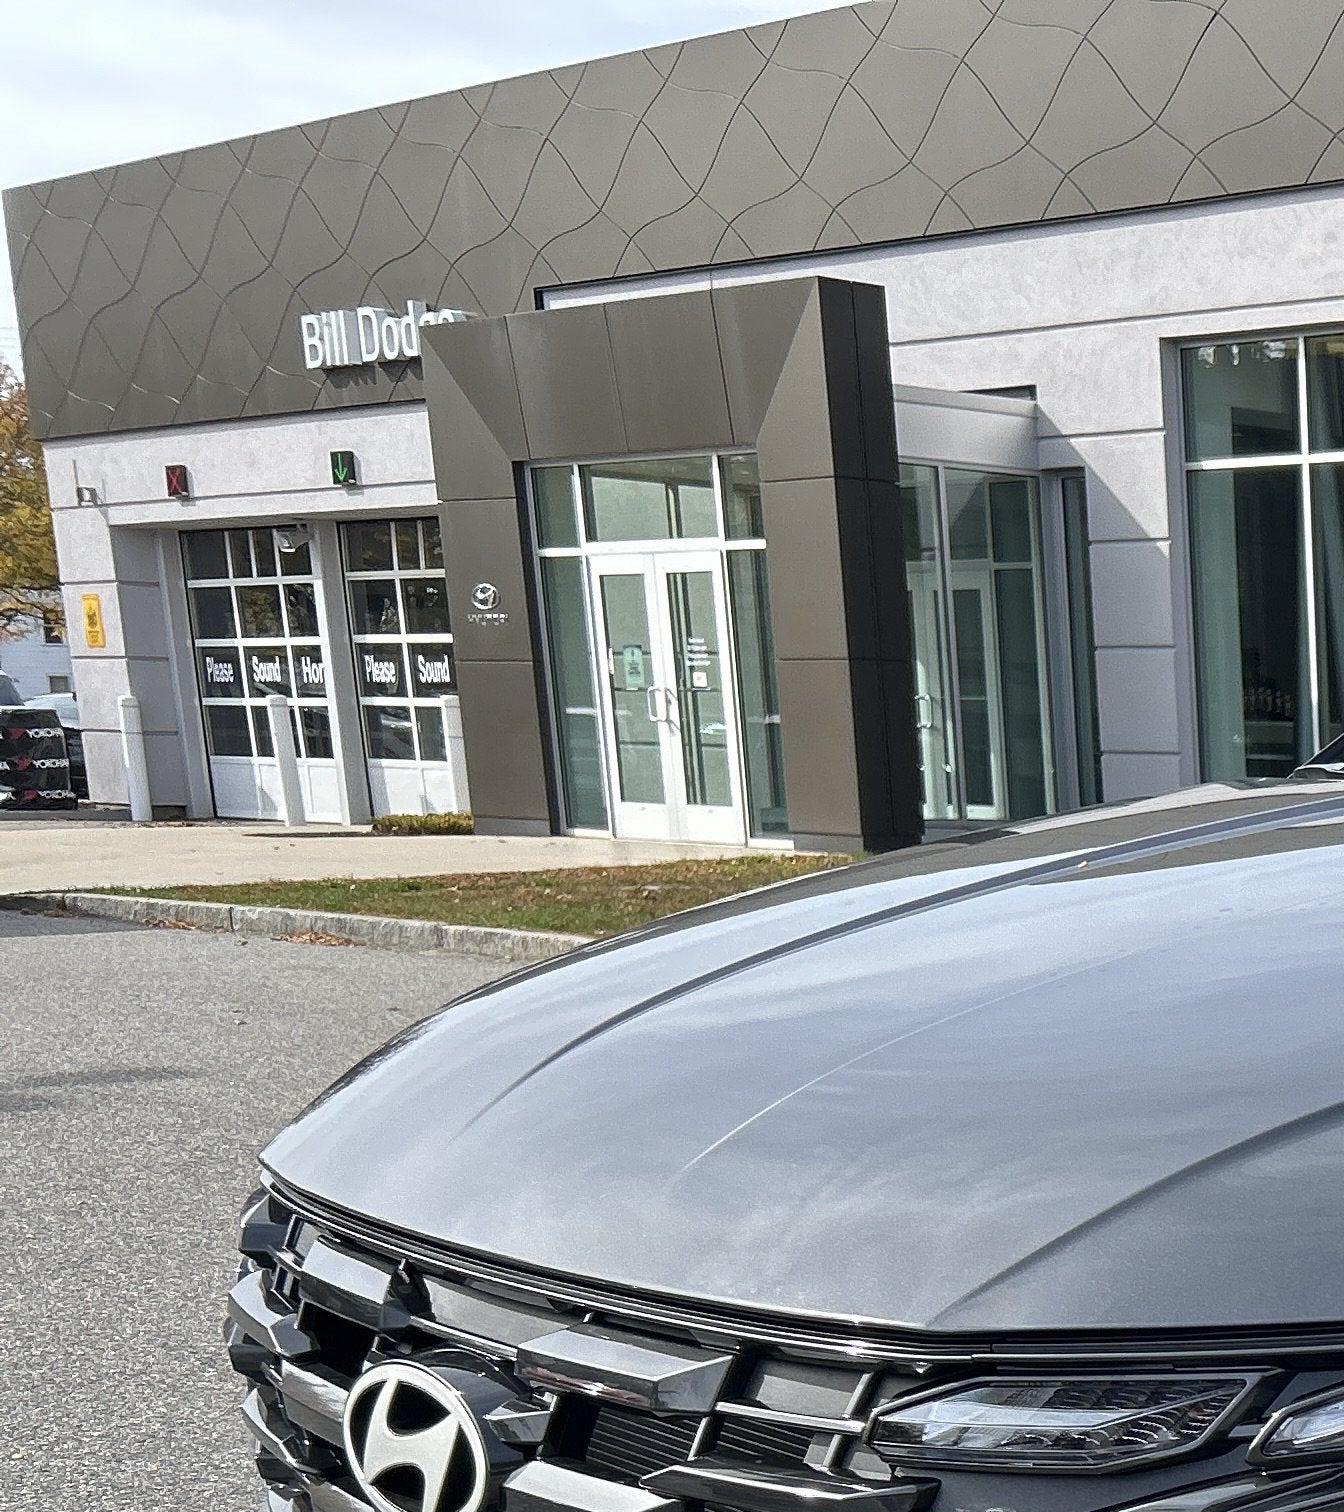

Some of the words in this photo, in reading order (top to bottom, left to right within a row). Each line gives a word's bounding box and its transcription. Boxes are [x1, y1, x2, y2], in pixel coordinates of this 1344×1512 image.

[301, 310, 349, 369] Bill
[206, 656, 234, 683] Please
[252, 655, 282, 683] Sound
[364, 654, 396, 684] Please
[417, 654, 450, 684] Sound
